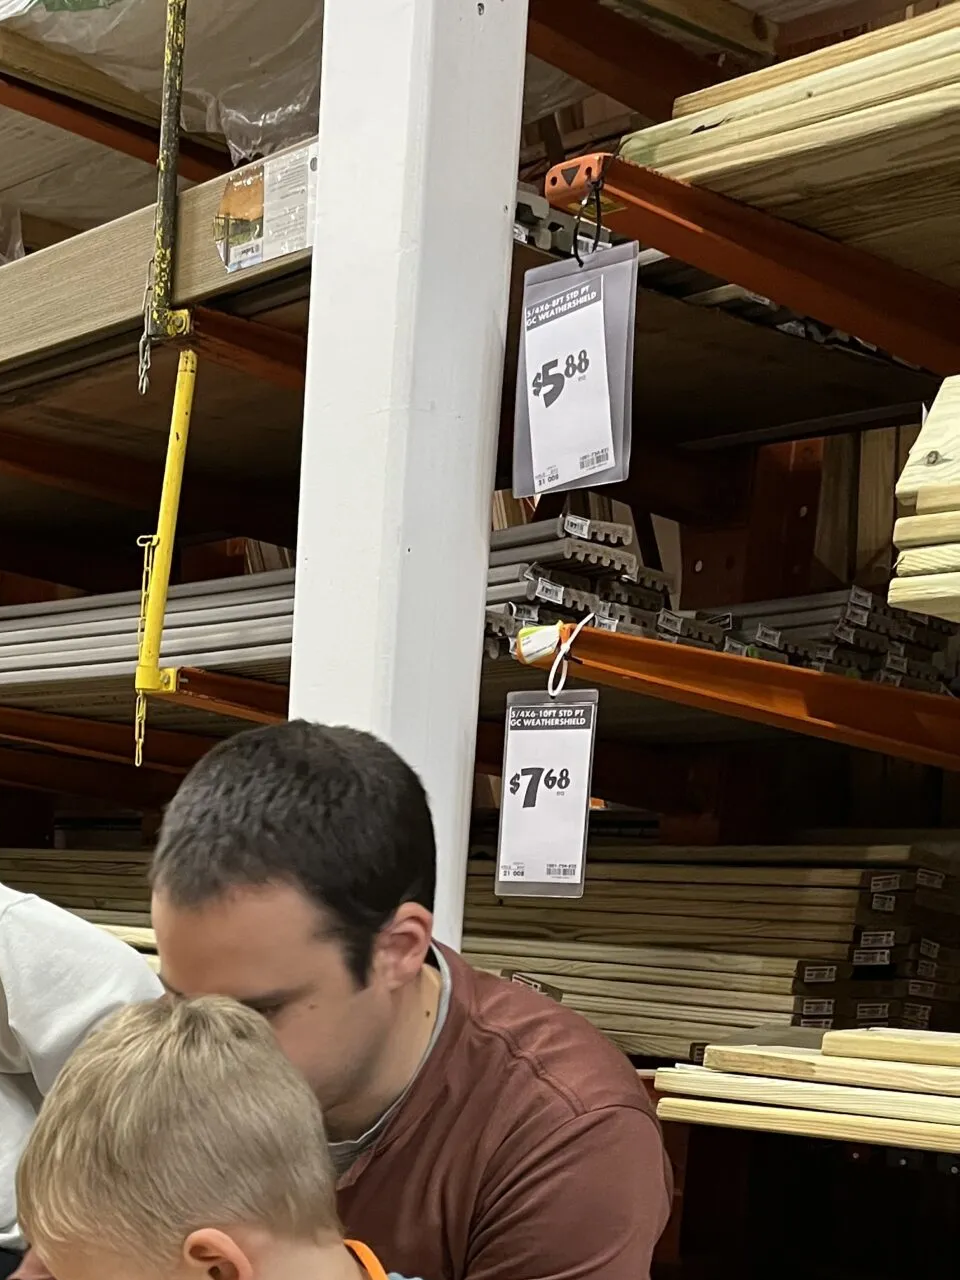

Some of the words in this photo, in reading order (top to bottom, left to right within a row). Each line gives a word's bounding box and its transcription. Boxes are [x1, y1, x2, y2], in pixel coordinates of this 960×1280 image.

[538, 291, 597, 323] WEATHERSHIELD
[574, 709, 584, 717] PT
[523, 717, 586, 727] WEATHERSHIELD
